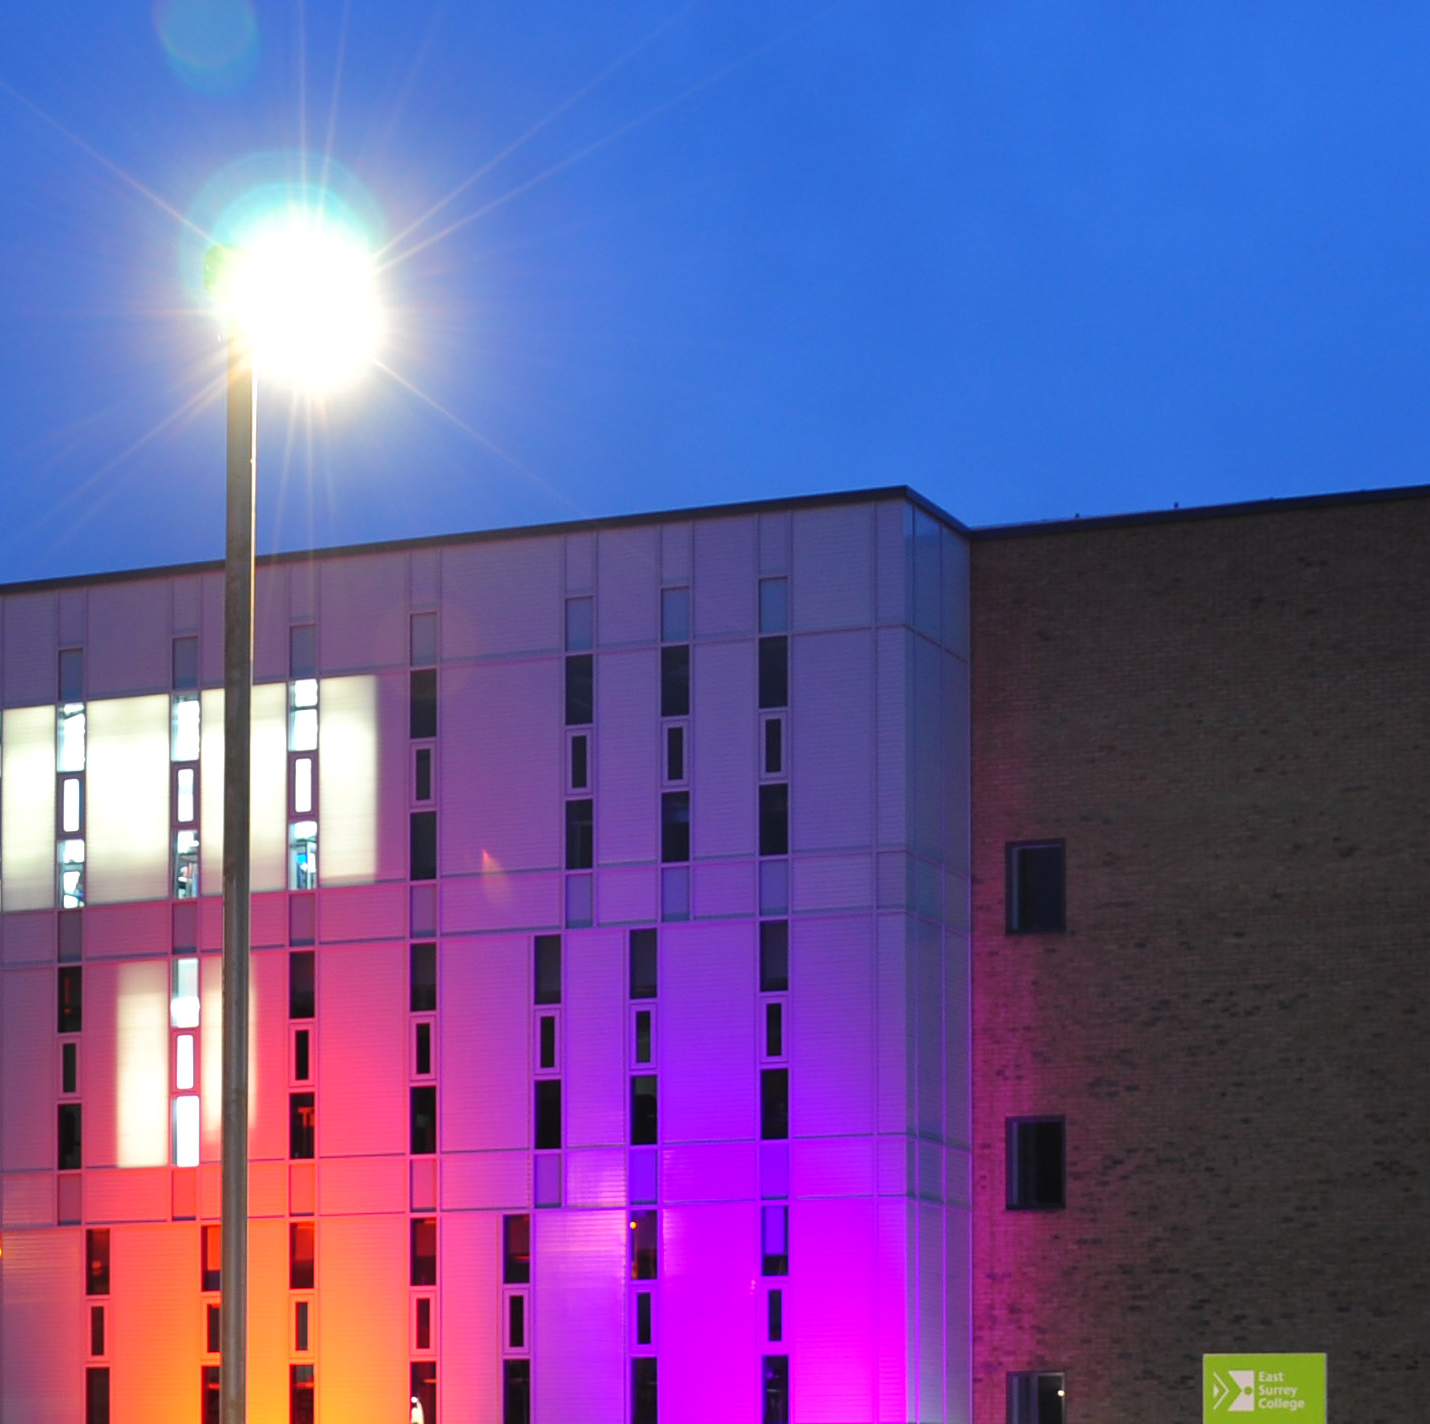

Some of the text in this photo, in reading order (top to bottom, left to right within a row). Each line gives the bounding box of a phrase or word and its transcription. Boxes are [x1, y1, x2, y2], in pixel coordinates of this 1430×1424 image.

[1258, 1371, 1284, 1382] East
[1258, 1385, 1298, 1397] Surrey
[1258, 1398, 1305, 1411] College
